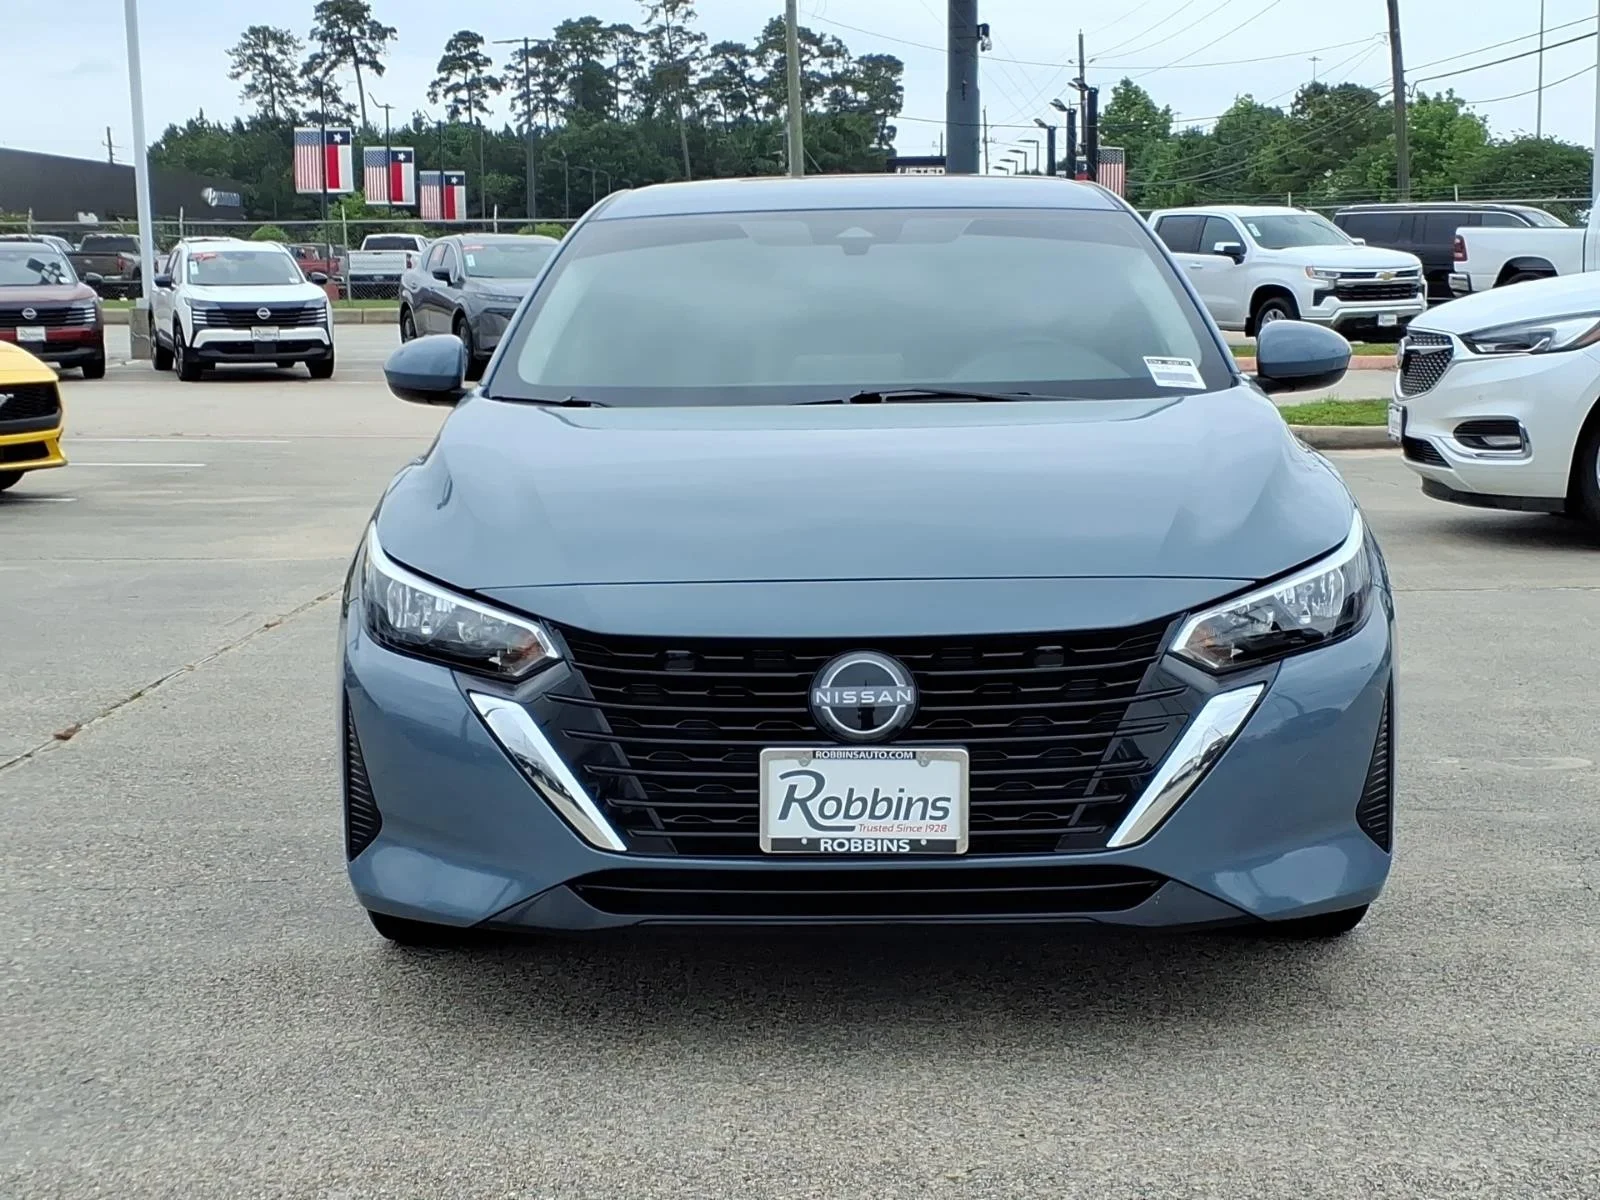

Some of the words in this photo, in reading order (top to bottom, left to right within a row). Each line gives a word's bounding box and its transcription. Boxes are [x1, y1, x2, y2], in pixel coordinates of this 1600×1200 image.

[815, 689, 912, 705] NISSAN
[815, 750, 914, 760] ROBBINSAUTO.COM
[778, 769, 951, 832] Robbins
[858, 823, 894, 833] Trusted
[896, 823, 923, 833] Since
[925, 823, 948, 833] 1928
[820, 838, 910, 852] ROBBINS
